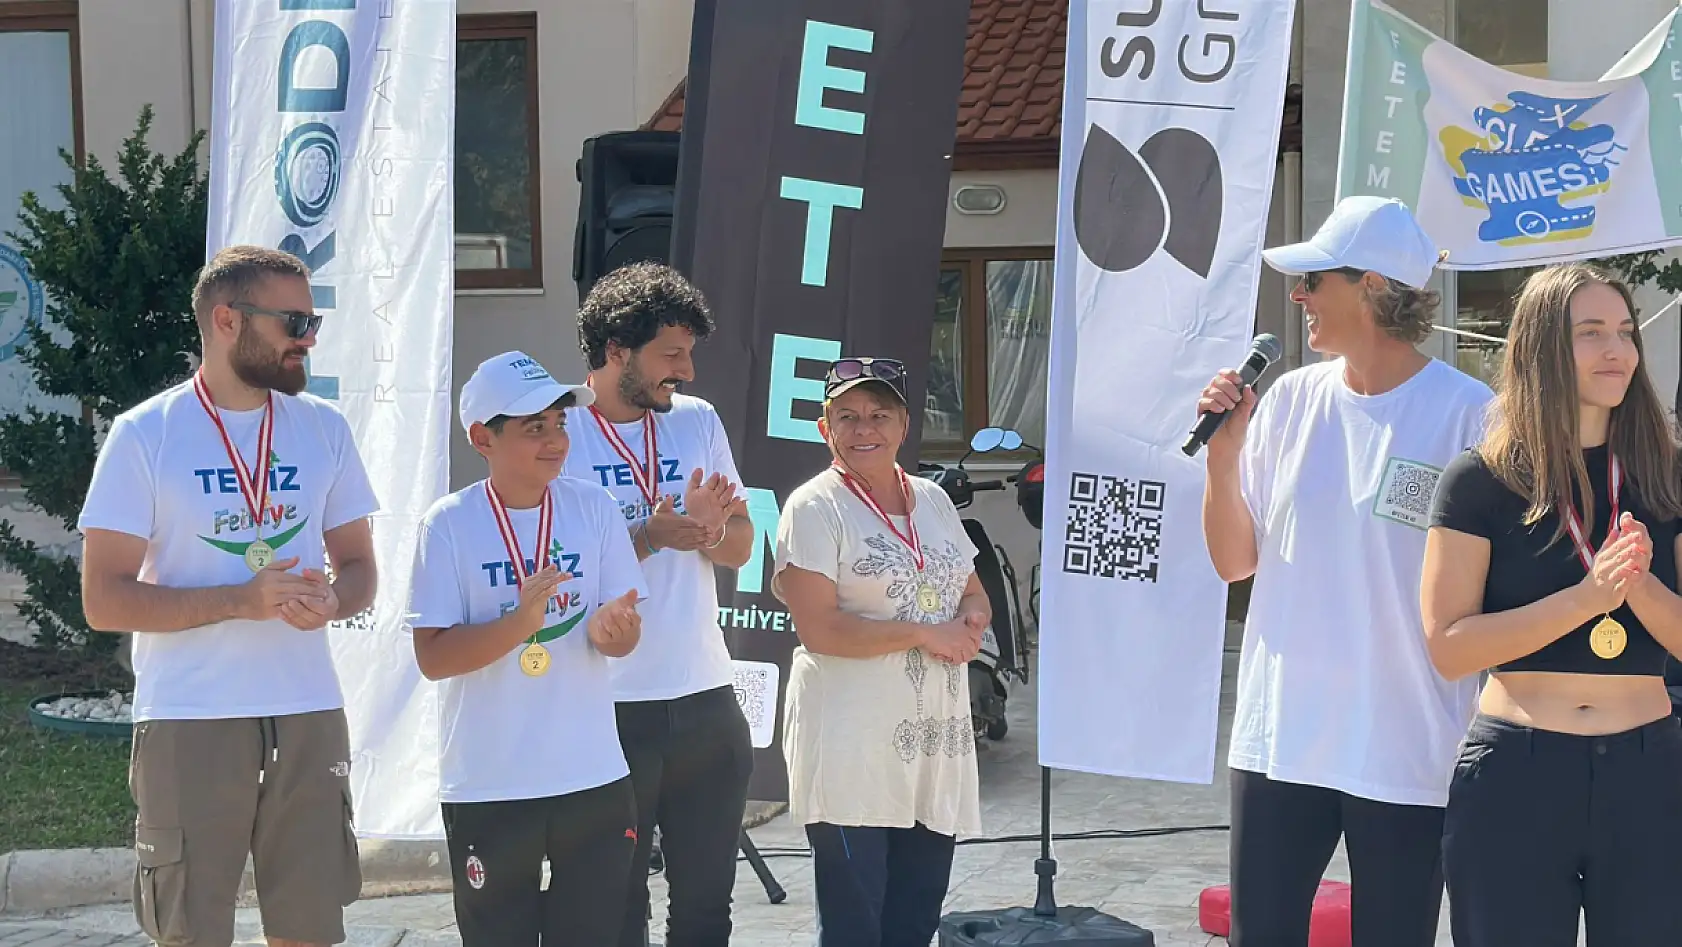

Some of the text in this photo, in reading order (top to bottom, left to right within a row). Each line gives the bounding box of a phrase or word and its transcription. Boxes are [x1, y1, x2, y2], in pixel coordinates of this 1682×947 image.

[1466, 162, 1588, 205] GAMES
[370, 0, 395, 403] REAL ESTATE
[258, 557, 265, 567] 2
[718, 603, 797, 632] THİYE'
[1606, 639, 1613, 650] 1
[532, 660, 540, 669] 2
